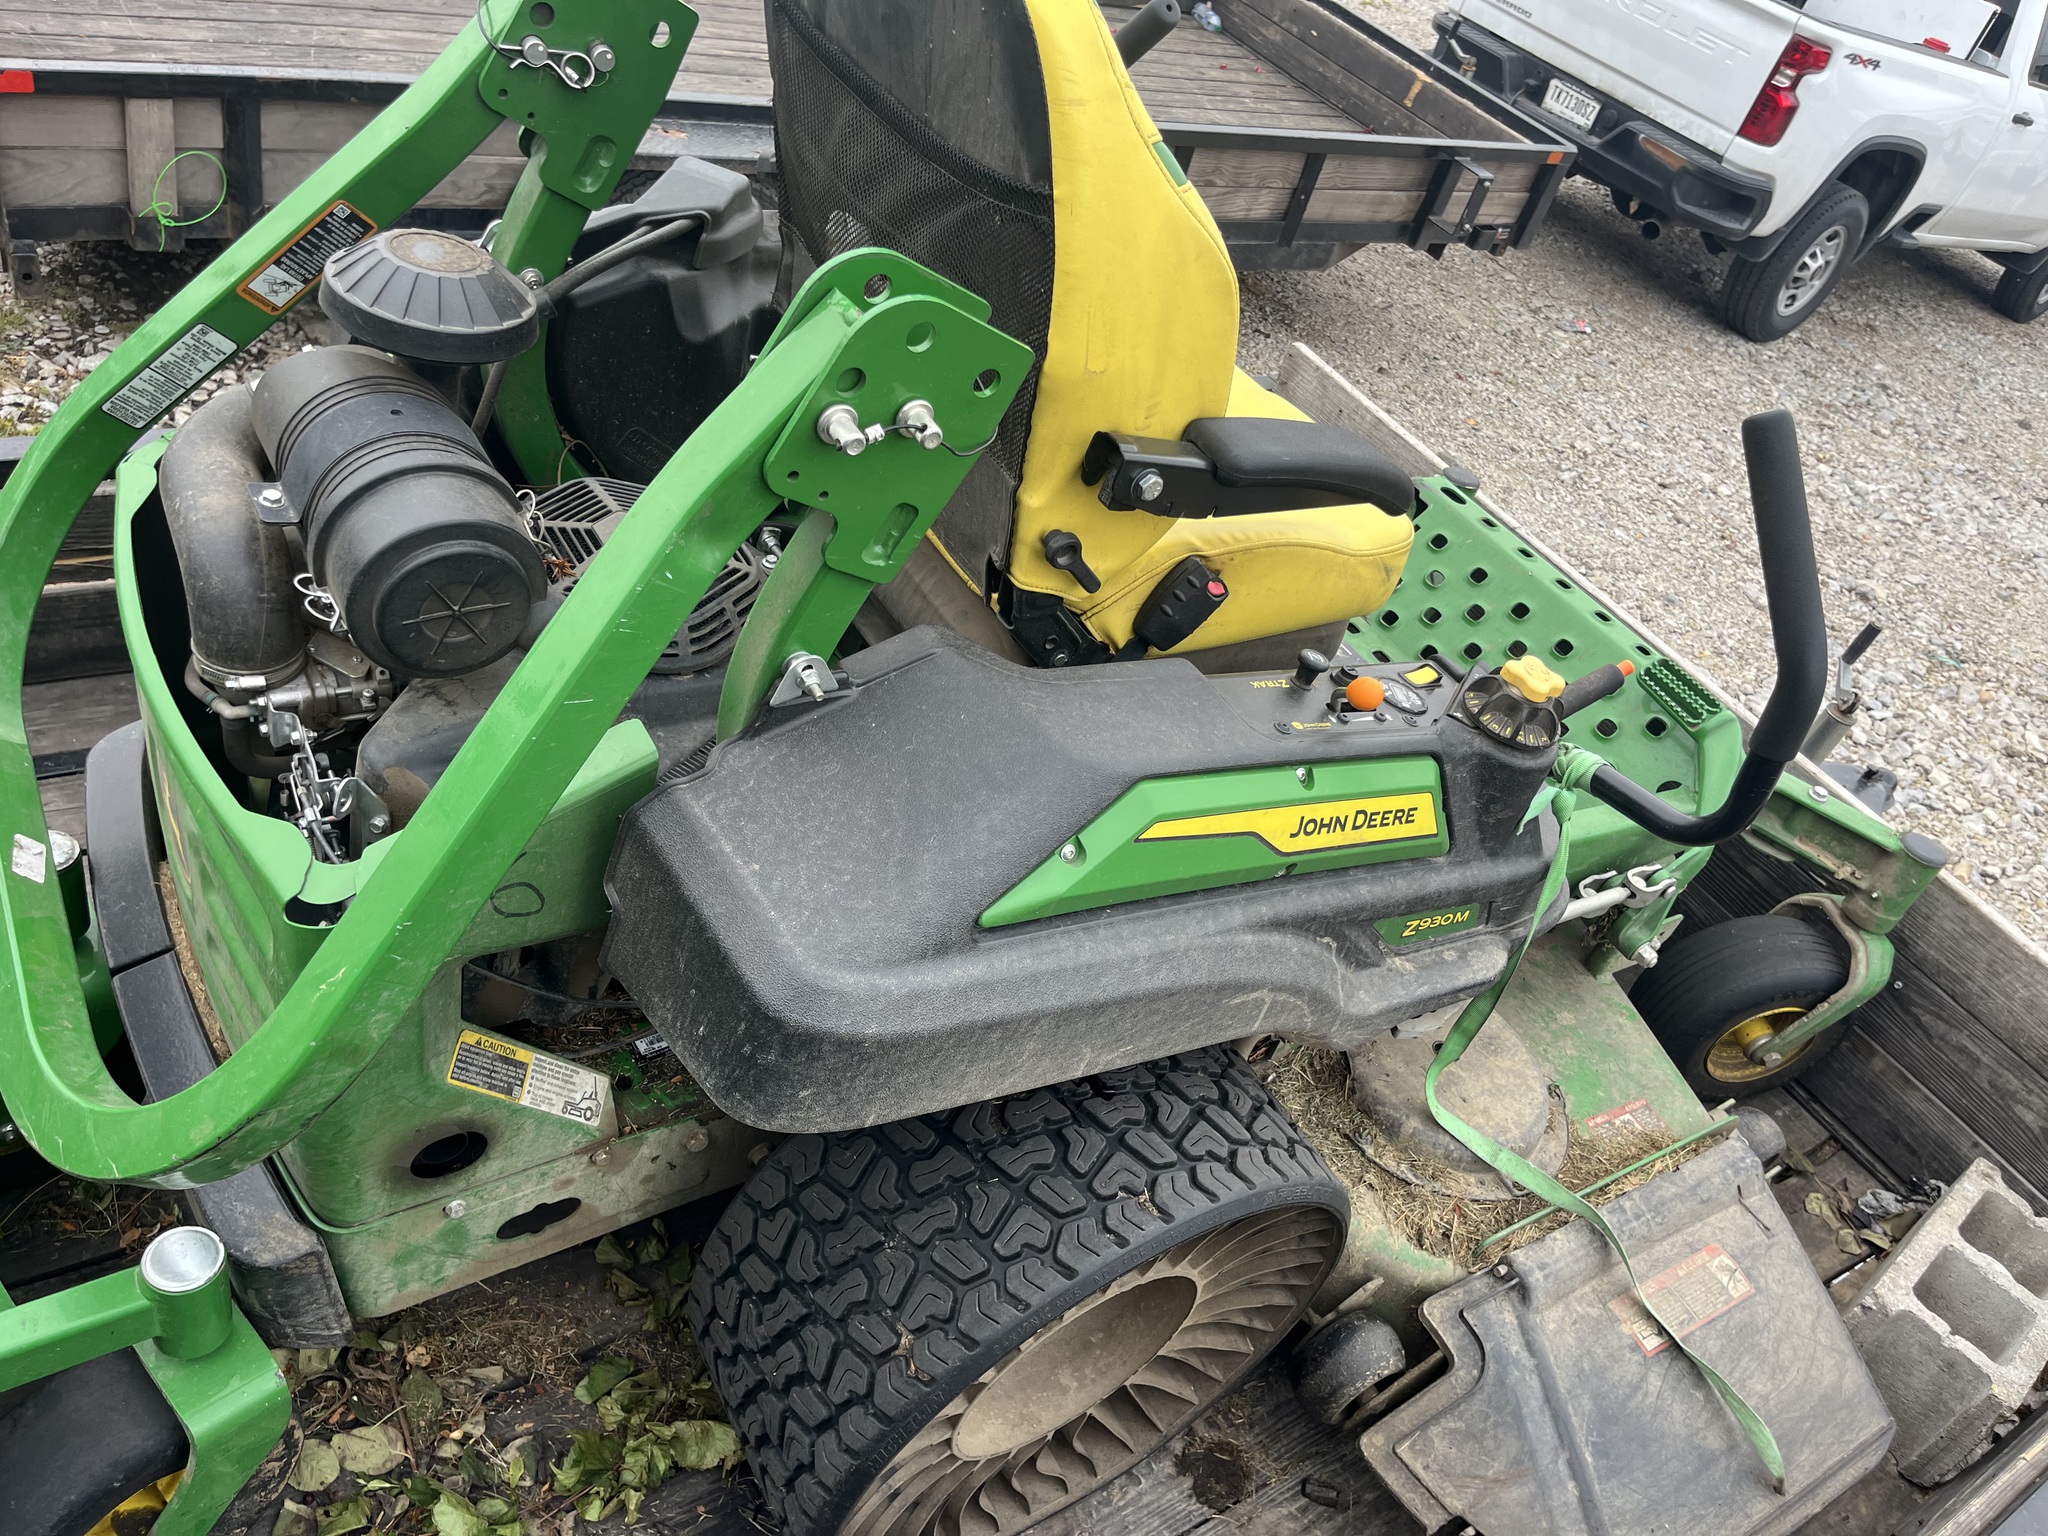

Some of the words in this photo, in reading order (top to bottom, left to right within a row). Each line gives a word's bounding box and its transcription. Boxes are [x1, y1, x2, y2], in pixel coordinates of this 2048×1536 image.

[1249, 679, 1291, 689] ZTRAK
[1289, 815, 1349, 839] JOHN
[1351, 806, 1418, 831] DEERE
[1401, 909, 1471, 939] Z930M
[483, 1039, 518, 1058] CAUTION
[864, 1391, 945, 1474] MICHELIN
